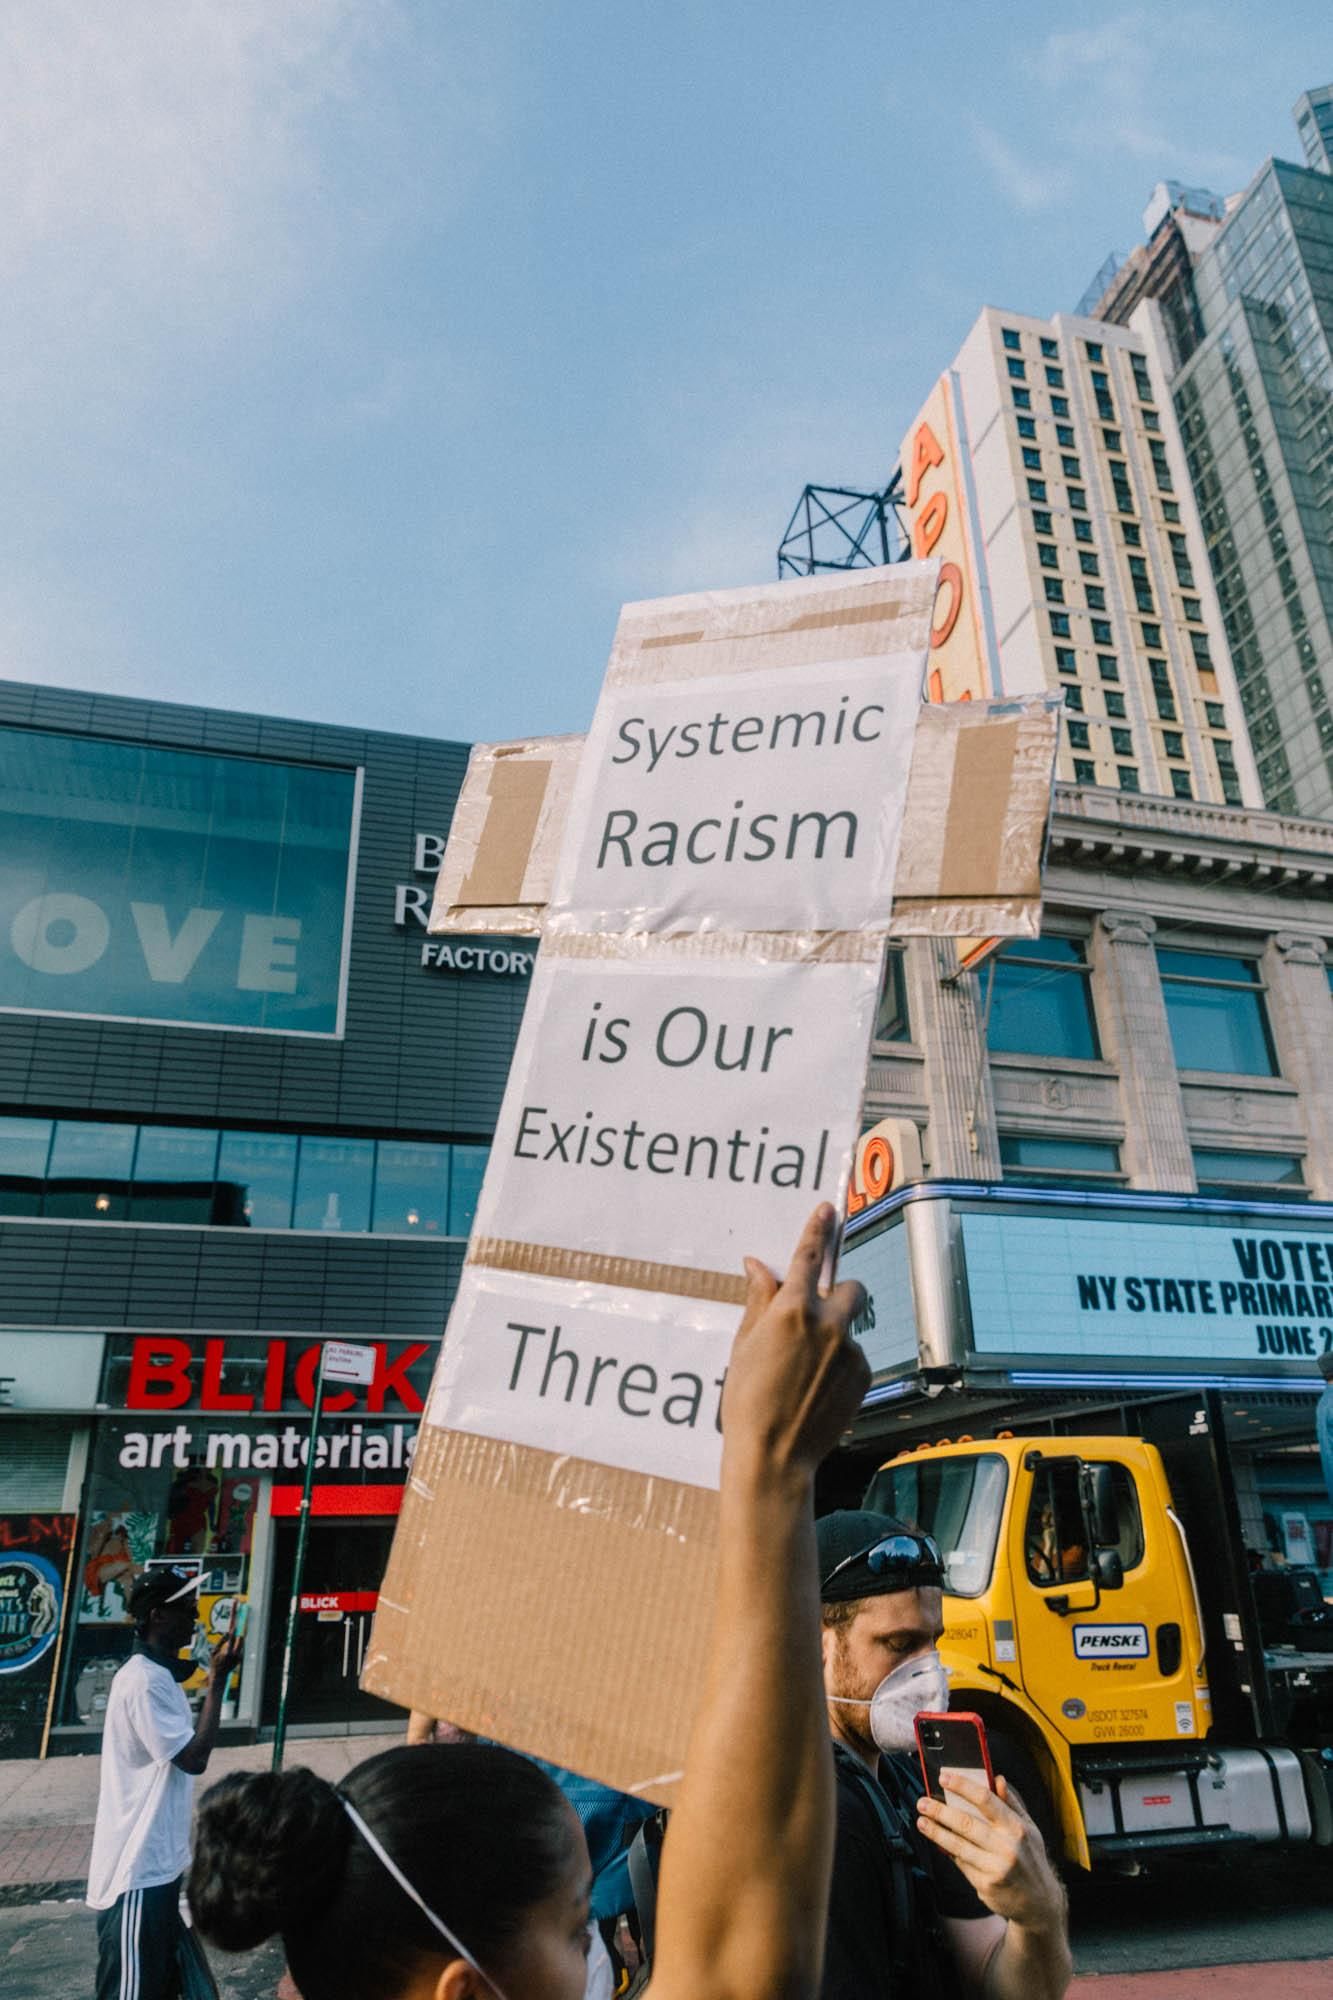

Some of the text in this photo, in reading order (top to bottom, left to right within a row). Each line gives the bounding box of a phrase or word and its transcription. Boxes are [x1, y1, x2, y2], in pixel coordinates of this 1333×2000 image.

[612, 695, 884, 773] Systemic
[597, 801, 858, 869] Racism
[582, 1002, 793, 1074] is Our
[514, 1106, 830, 1191] Existential
[1077, 1275, 1333, 1318] NY STATE PRIMAR
[1256, 1324, 1317, 1355] JUNE
[127, 1336, 430, 1413] BLICK
[119, 1425, 192, 1469] art
[301, 1597, 338, 1608] BLICK
[1080, 1634, 1142, 1648] PENSKE
[1087, 1710, 1118, 1722] USDOT
